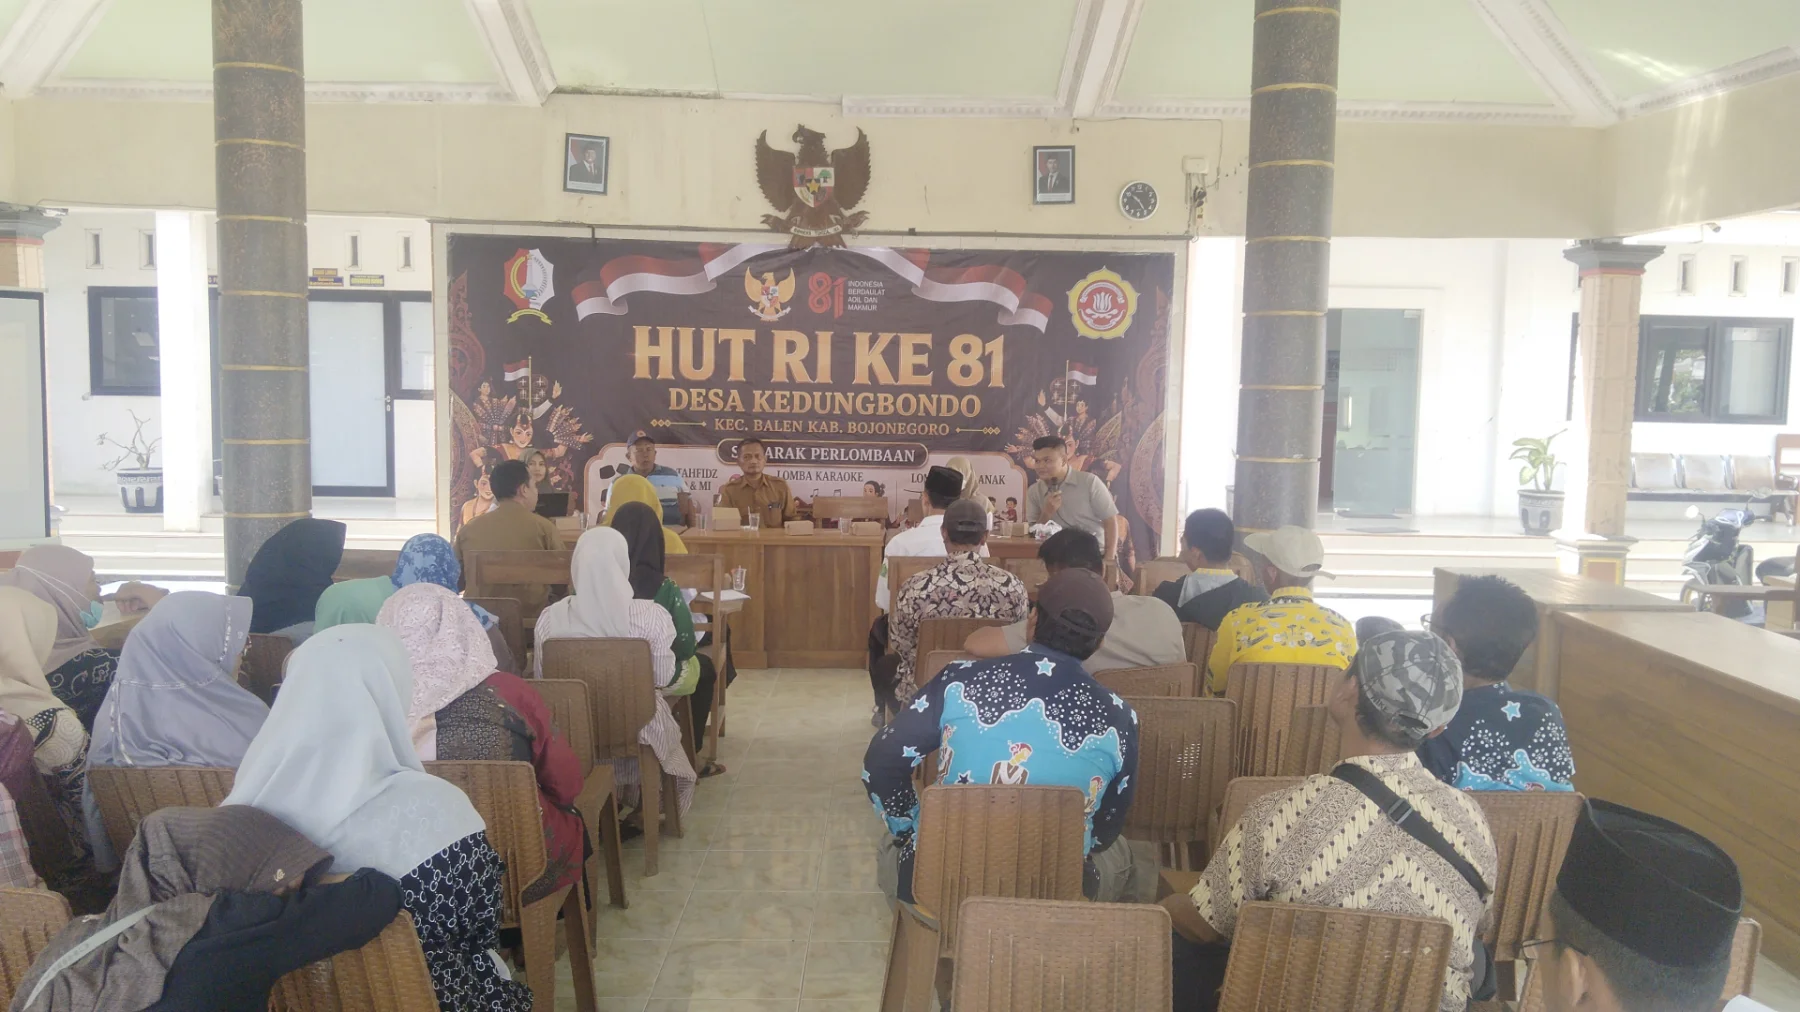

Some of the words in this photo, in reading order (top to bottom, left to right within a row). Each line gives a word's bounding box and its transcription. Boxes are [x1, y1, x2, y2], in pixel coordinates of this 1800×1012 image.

[847, 280, 884, 288] INDONESIA
[808, 271, 848, 319] 81
[847, 288, 886, 296] BERDAULAT
[863, 296, 878, 304] DAN
[632, 325, 756, 382] HUT
[770, 329, 834, 384] RI
[852, 331, 934, 387] KE
[946, 333, 1005, 388] 81
[668, 387, 746, 412] DESA
[752, 390, 982, 418] KEDUNGBONDO
[714, 418, 749, 432] KEC.
[753, 419, 803, 433] BALEN
[807, 420, 843, 434] KAB.
[847, 421, 950, 436] BOJONEGORO
[731, 445, 806, 460] SARAK
[811, 447, 915, 462] PERLOMBAAN
[676, 468, 718, 479] TAHFIDZ
[815, 471, 864, 482] KARAOKE
[978, 475, 1005, 485] ANAK
[699, 481, 711, 491] MI
